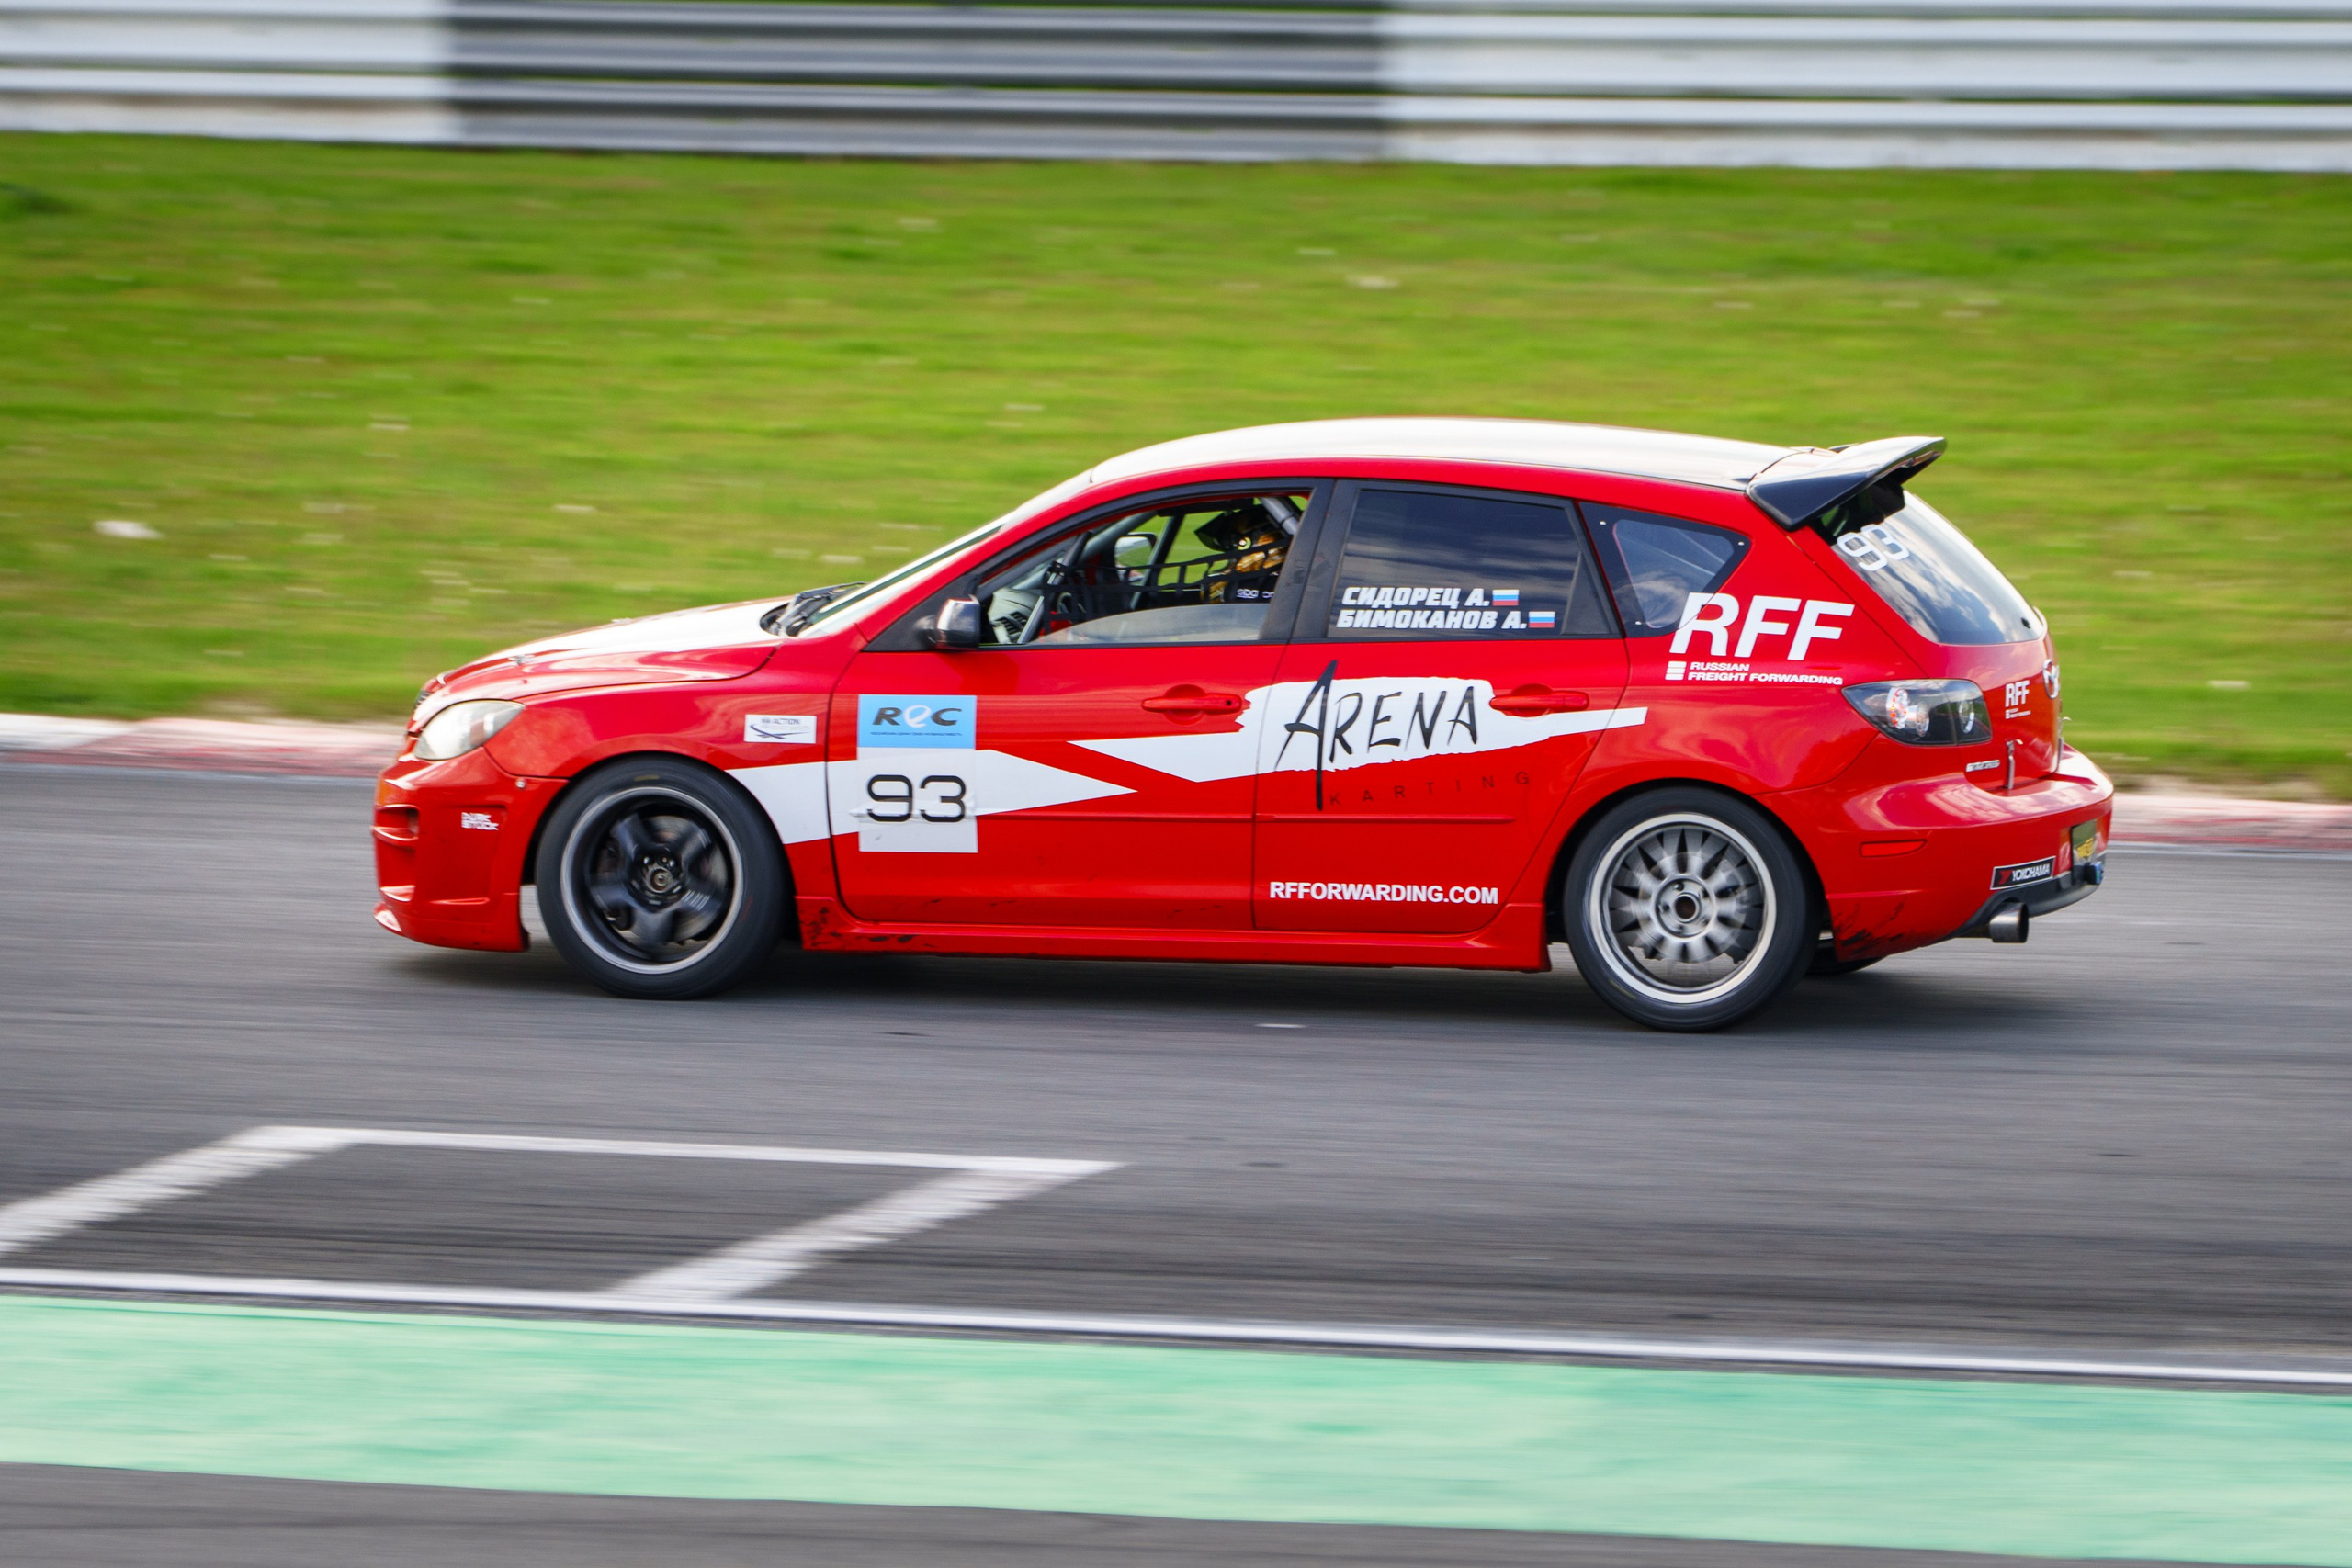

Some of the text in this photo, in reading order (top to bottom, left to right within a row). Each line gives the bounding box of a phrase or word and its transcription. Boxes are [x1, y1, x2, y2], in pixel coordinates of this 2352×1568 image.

[1837, 523, 1910, 571] 93
[1341, 586, 1490, 609] СИДОРЕЦ А.
[1336, 609, 1527, 629] БИМОКАНОВ А.
[1669, 592, 1855, 660] RFF
[1690, 661, 1750, 671] RUSSIAN
[1688, 672, 1843, 685] FREIGHT FORWARDING
[2005, 680, 2030, 707] RFF
[866, 773, 967, 822] 93
[2012, 863, 2051, 881] YOKOHAMA
[1270, 882, 1498, 904] RFFORWARDING.COM
